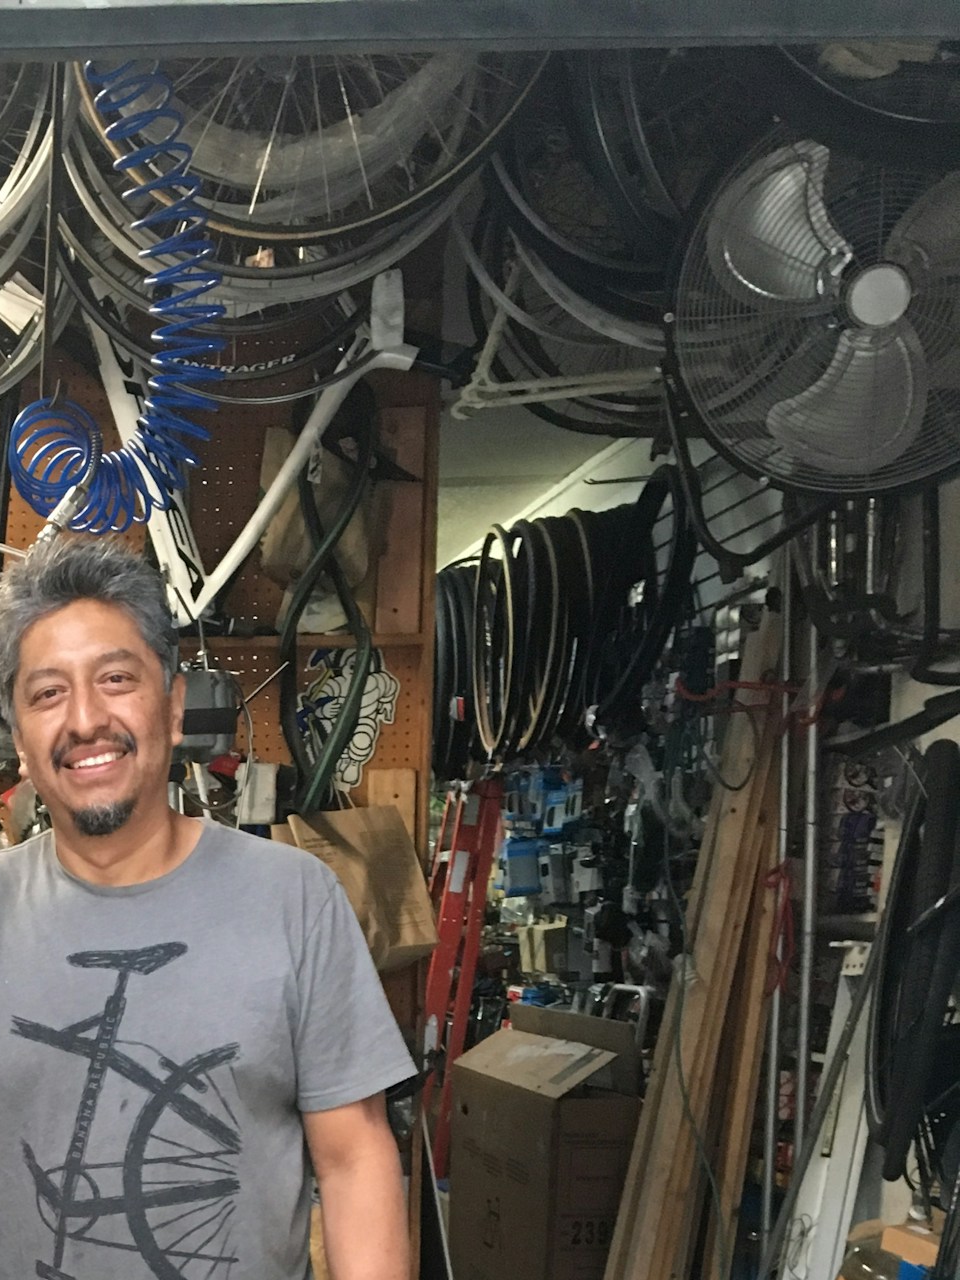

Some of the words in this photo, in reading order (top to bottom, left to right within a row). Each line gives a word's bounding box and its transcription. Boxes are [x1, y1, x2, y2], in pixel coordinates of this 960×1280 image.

[169, 353, 296, 373] ONTRAGER
[71, 1099, 94, 1159] BANANA
[89, 1015, 117, 1090] REPUBLIC
